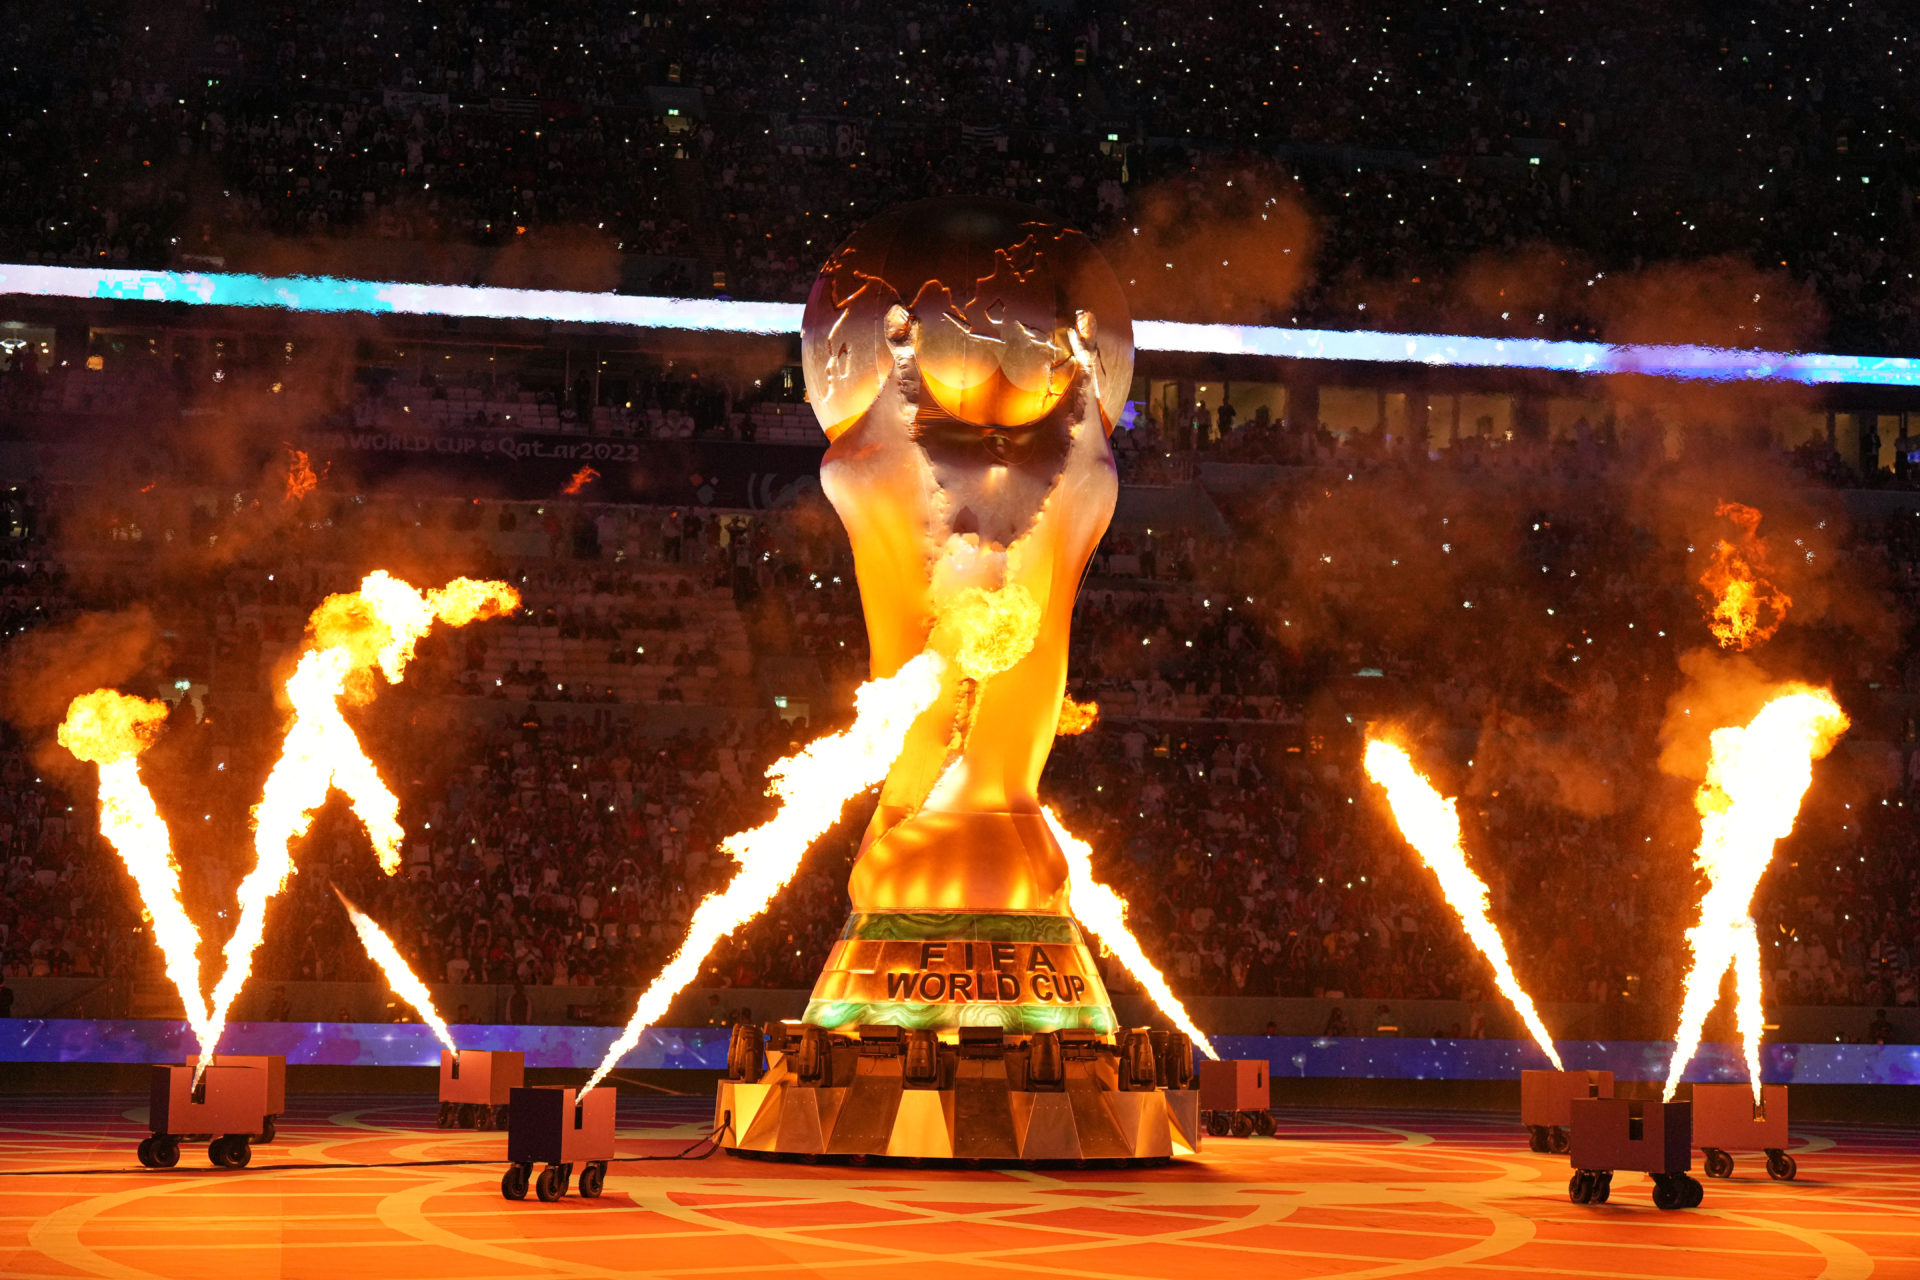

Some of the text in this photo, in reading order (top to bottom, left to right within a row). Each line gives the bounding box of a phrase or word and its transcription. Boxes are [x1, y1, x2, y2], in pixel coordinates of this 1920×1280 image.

[350, 432, 430, 451] WORLD
[433, 437, 474, 453] CUP
[918, 943, 1056, 972] FIFA
[887, 973, 1086, 1003] WORLD CUP
